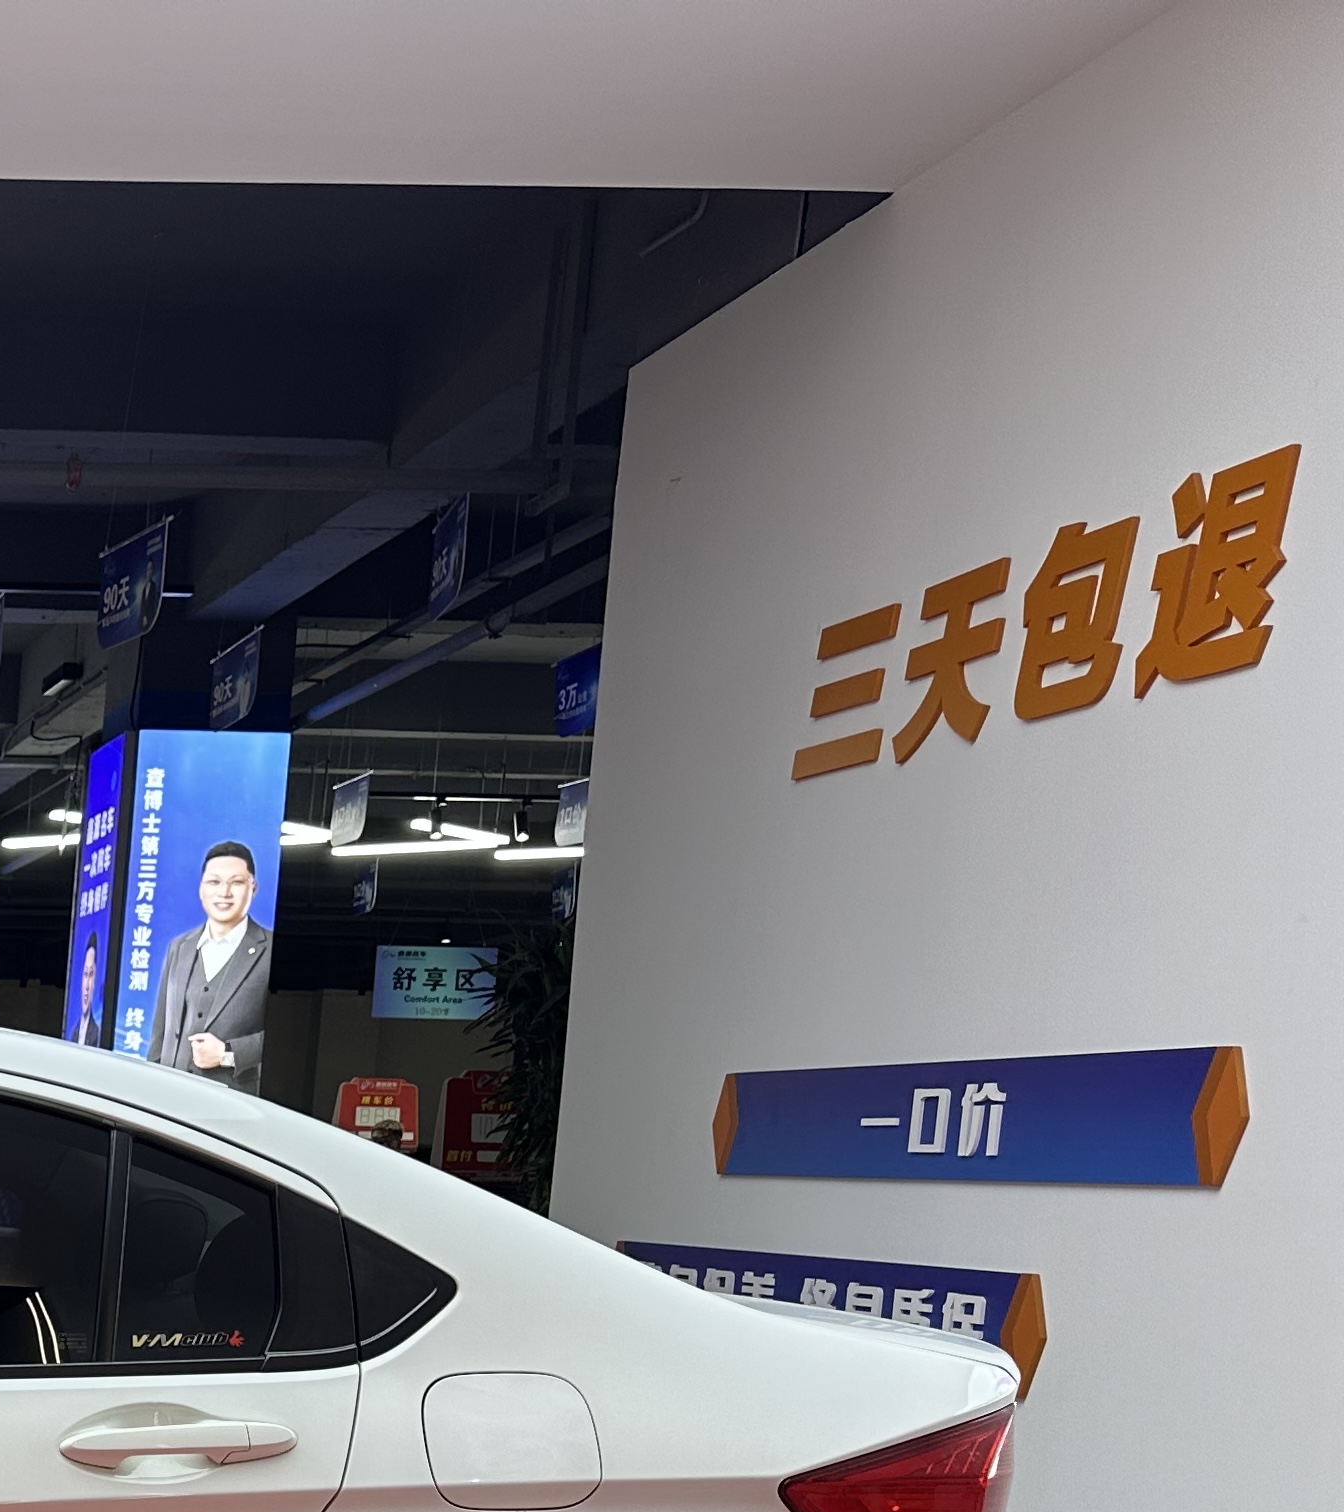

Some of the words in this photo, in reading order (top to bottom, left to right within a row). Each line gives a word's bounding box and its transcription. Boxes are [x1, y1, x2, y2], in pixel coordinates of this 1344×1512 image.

[102, 575, 130, 614] 90天
[791, 443, 1302, 781] 三天包退
[128, 767, 166, 992] 查博士第三方专业检测
[392, 966, 477, 992] 舒享区
[404, 994, 440, 1003] Comfort
[441, 995, 463, 1004] Area
[123, 1007, 145, 1051] 终身
[860, 1082, 1008, 1159] 一口价
